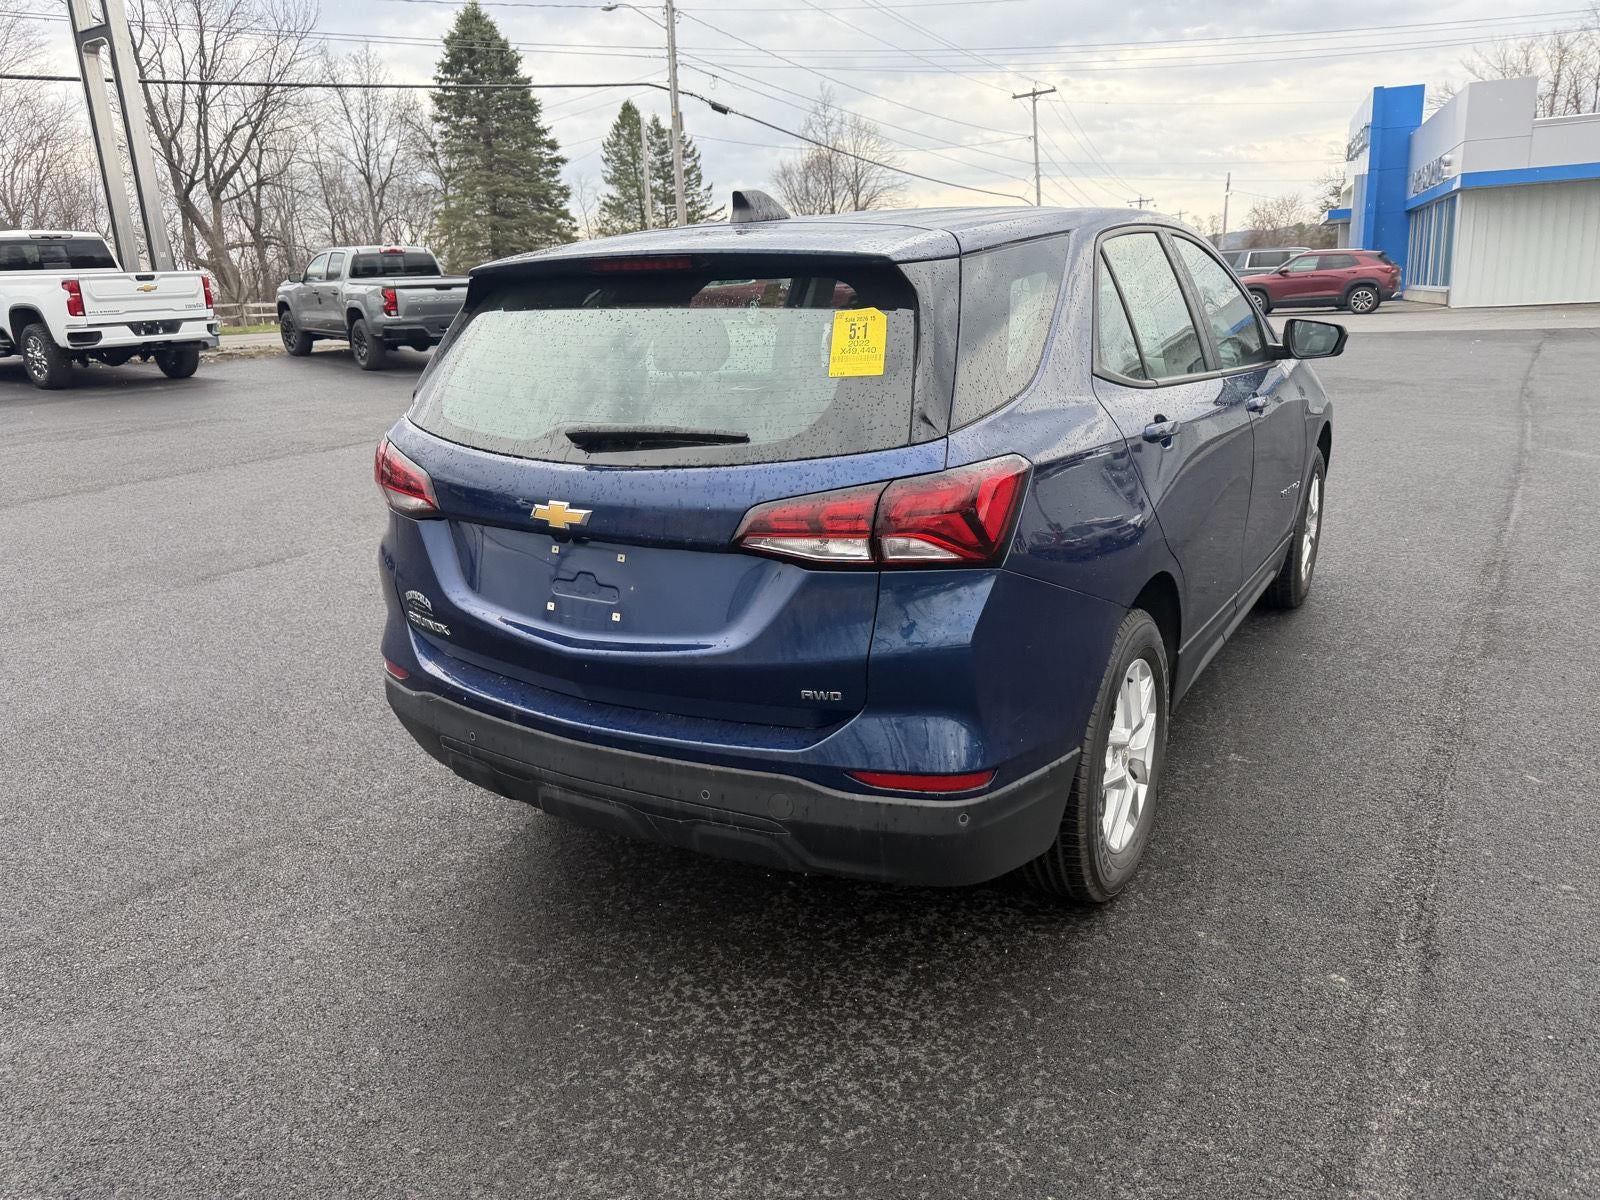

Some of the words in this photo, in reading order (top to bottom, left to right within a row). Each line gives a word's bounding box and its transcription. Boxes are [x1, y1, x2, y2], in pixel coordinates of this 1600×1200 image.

[849, 322, 868, 340] 5:1
[840, 346, 877, 355] X49,440
[800, 690, 842, 701] AWD
